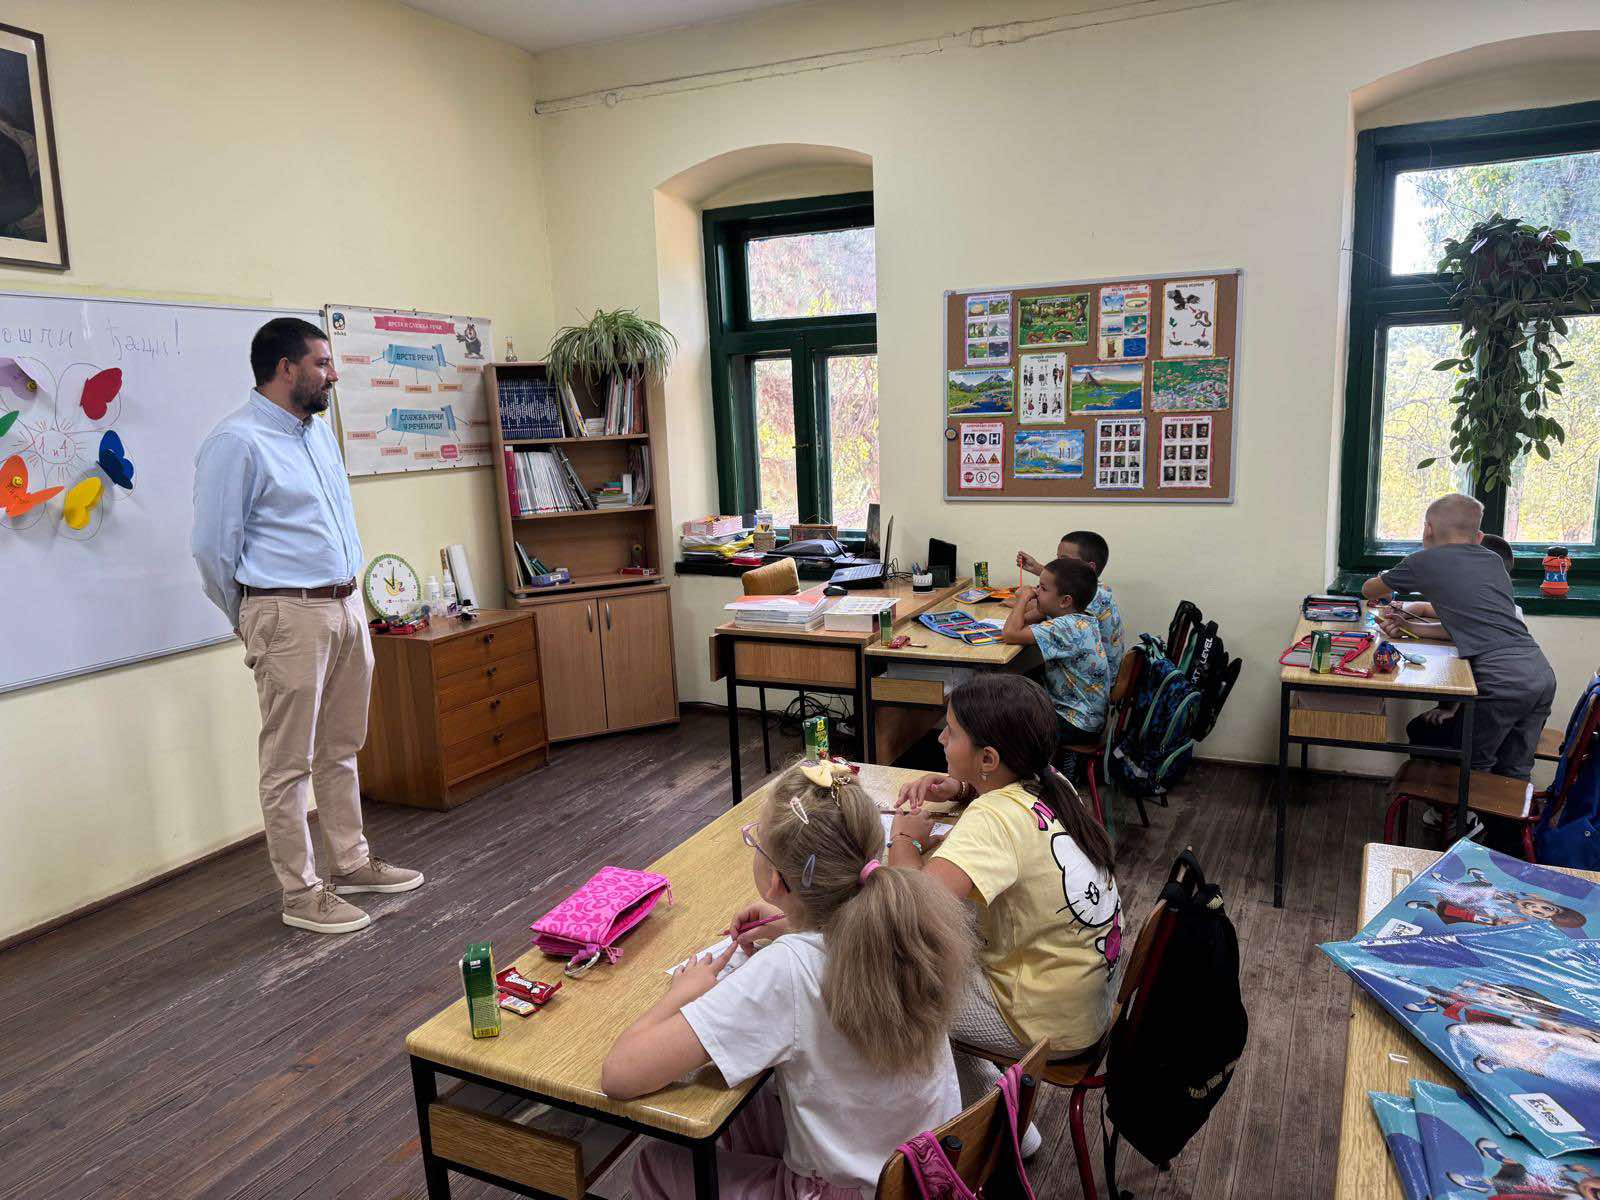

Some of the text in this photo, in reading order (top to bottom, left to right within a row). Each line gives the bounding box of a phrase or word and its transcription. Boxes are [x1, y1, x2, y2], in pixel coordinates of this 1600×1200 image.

[396, 353, 433, 361] ВРСТЕ РЕЧИ
[400, 413, 444, 422] СЛУЖБА РЕЧИ
[408, 422, 443, 431] РЕЧЕНИЦИ
[1200, 637, 1213, 664] LEVEL
